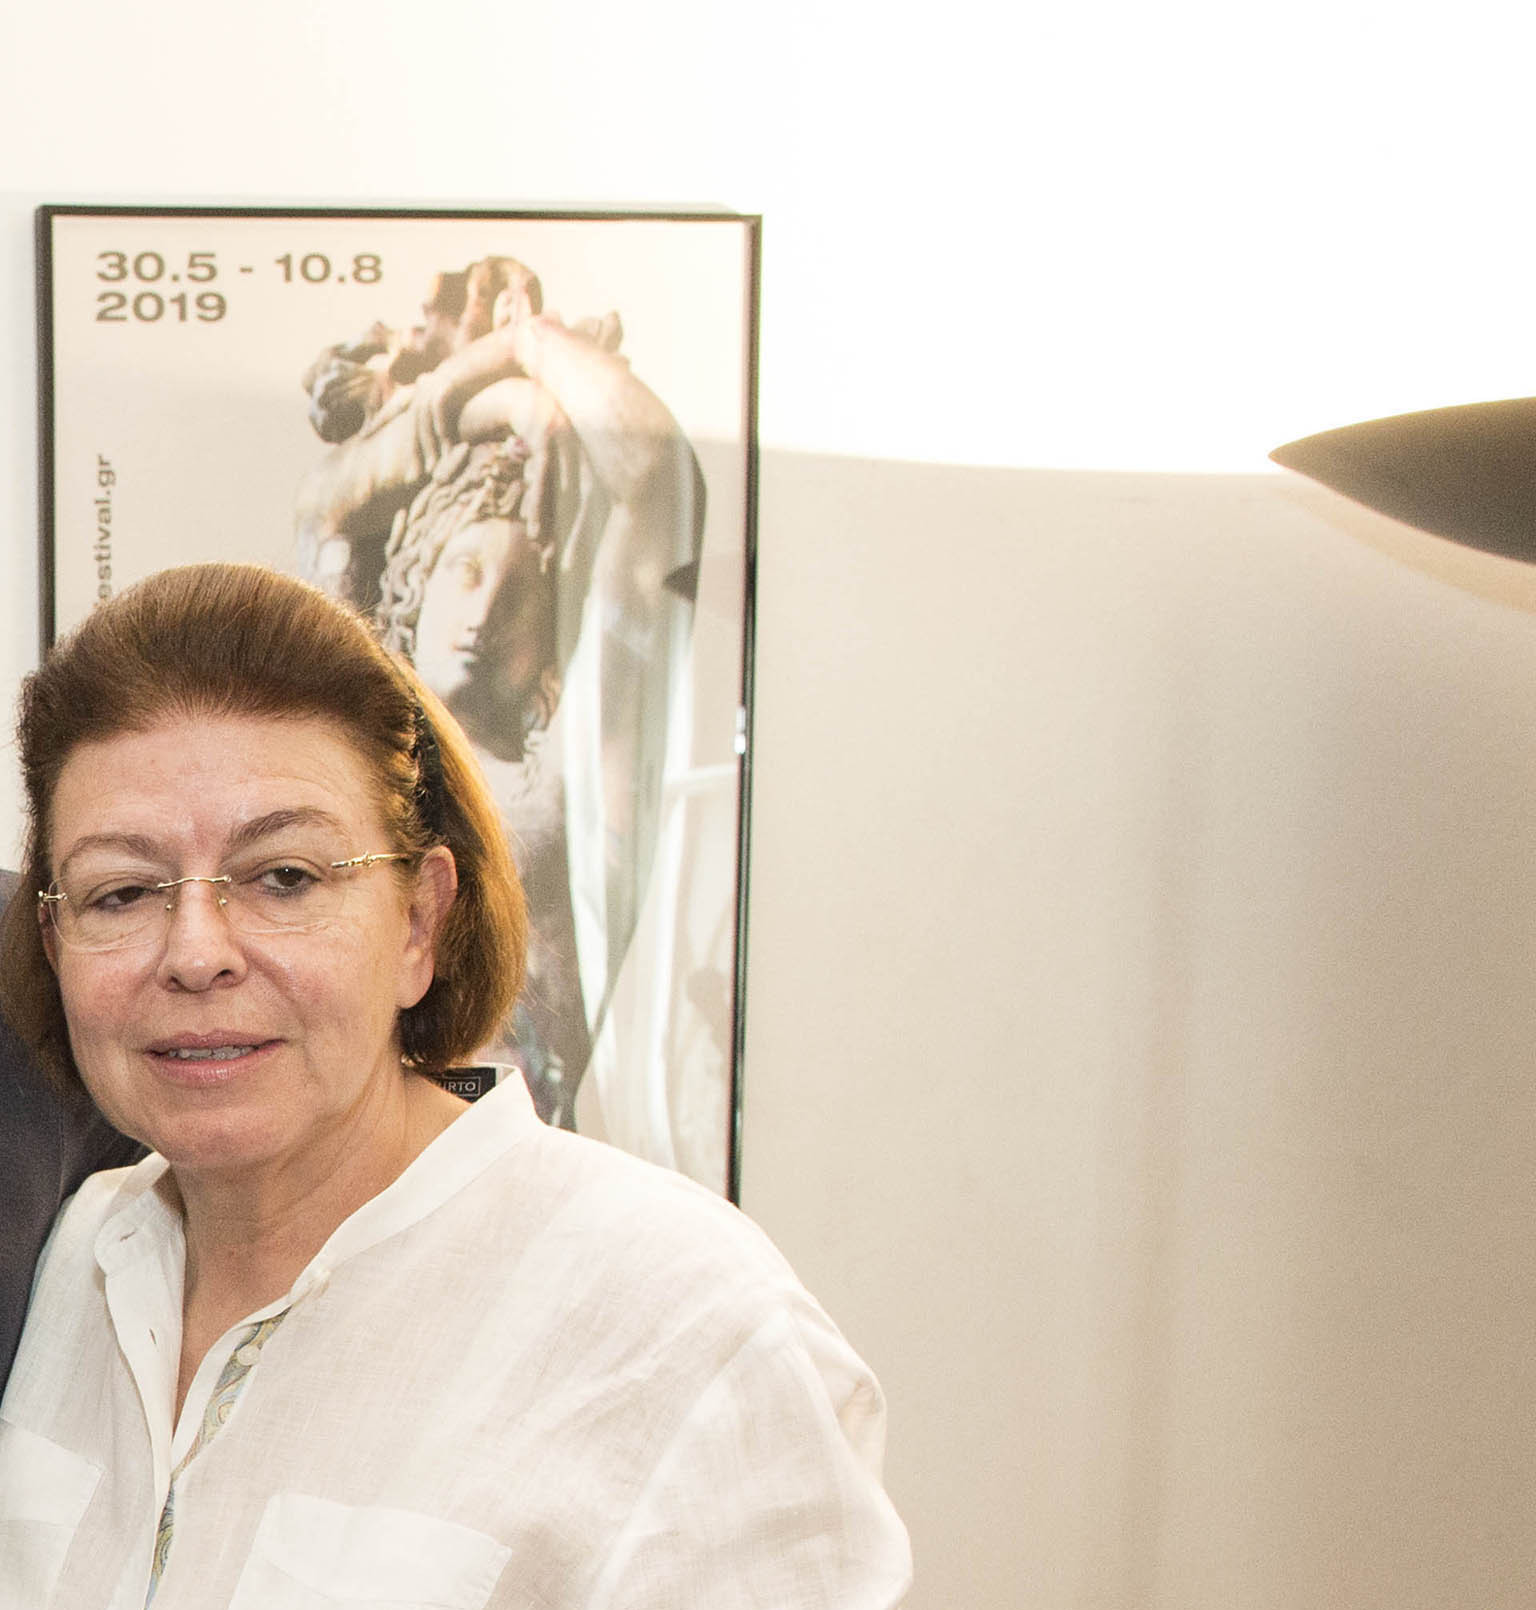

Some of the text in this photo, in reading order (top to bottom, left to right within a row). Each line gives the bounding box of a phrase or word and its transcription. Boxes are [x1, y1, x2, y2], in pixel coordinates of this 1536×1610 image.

[96, 251, 218, 282] 30.5
[275, 253, 383, 284] 10.8
[95, 292, 228, 322] 2019
